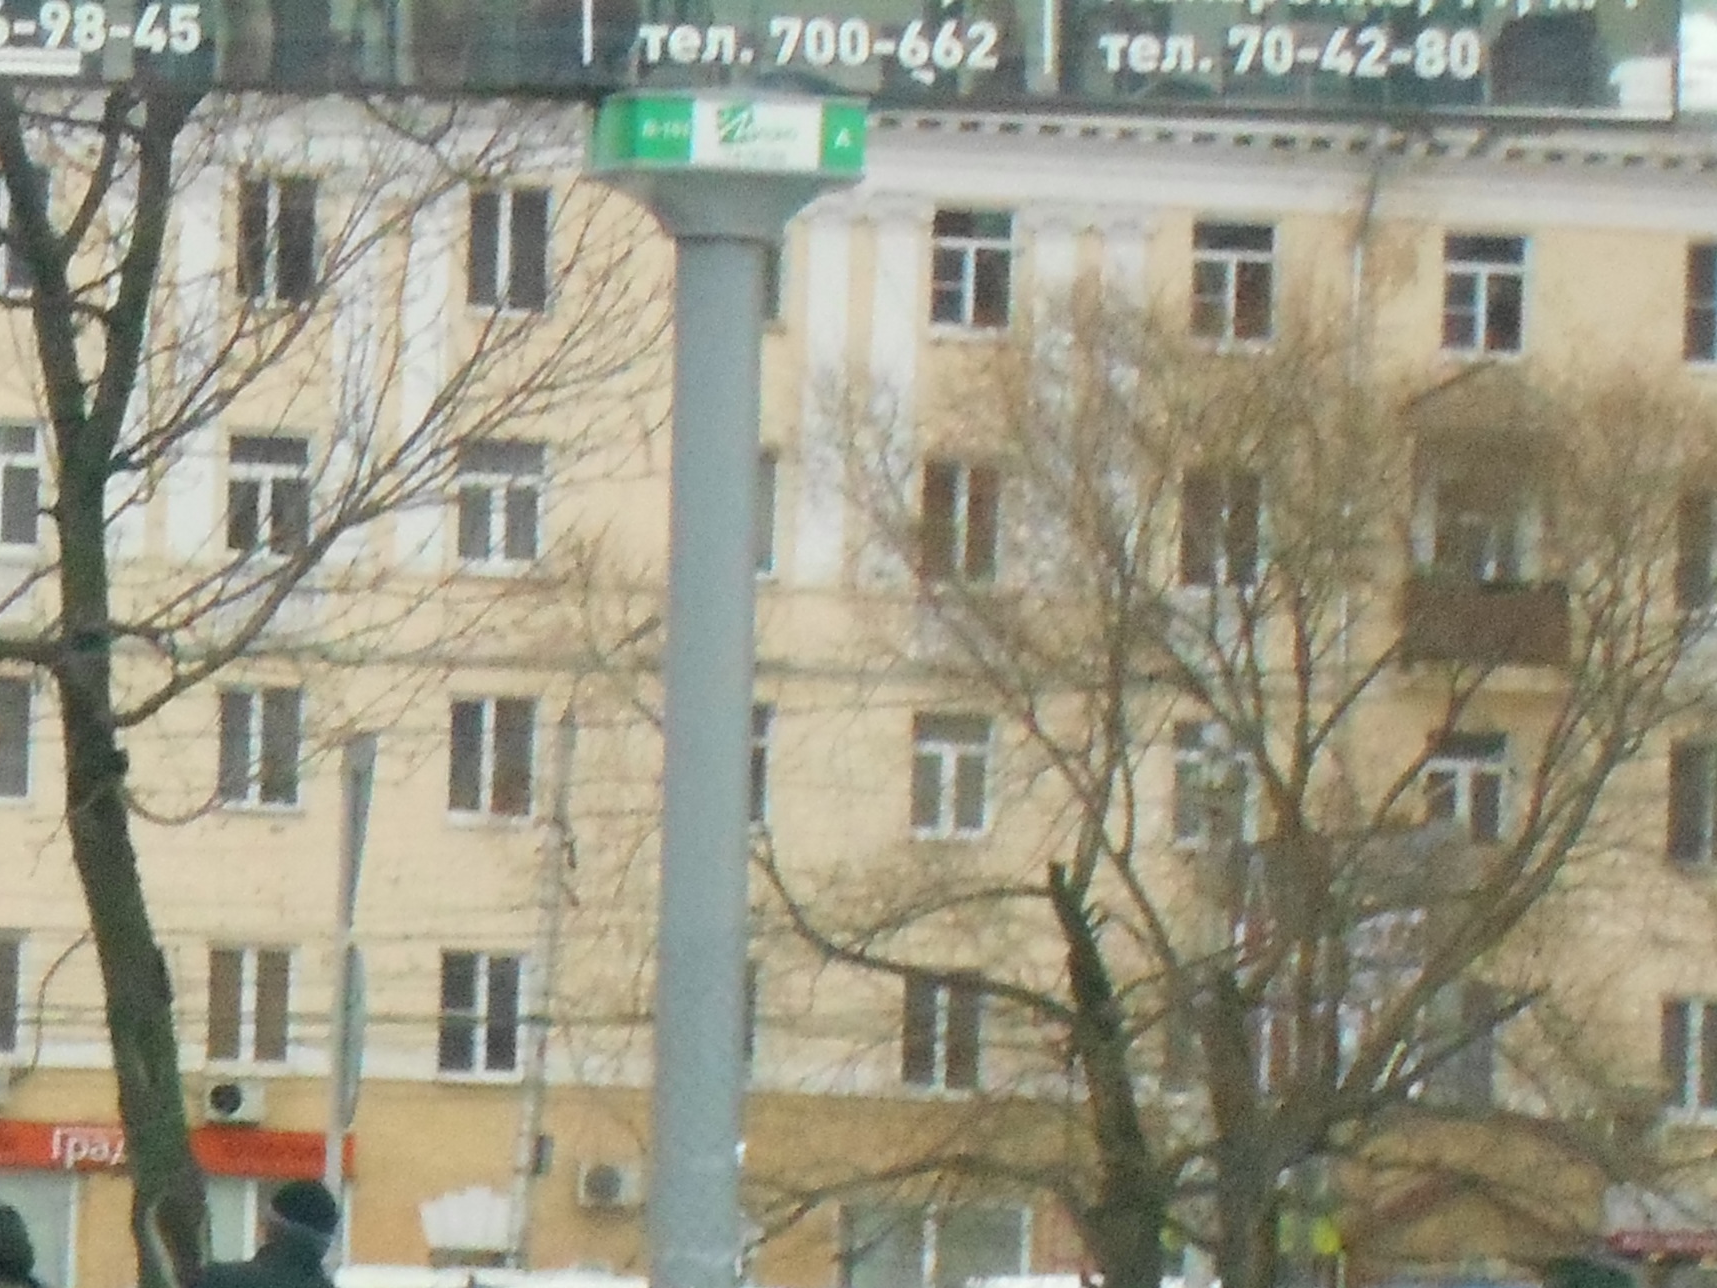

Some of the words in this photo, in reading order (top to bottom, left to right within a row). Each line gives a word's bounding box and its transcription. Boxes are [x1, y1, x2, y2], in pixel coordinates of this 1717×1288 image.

[638, 23, 755, 65] тел.
[769, 15, 999, 70] 700-662
[1098, 32, 1213, 74] тел.
[1226, 24, 1481, 80] 70-42-80
